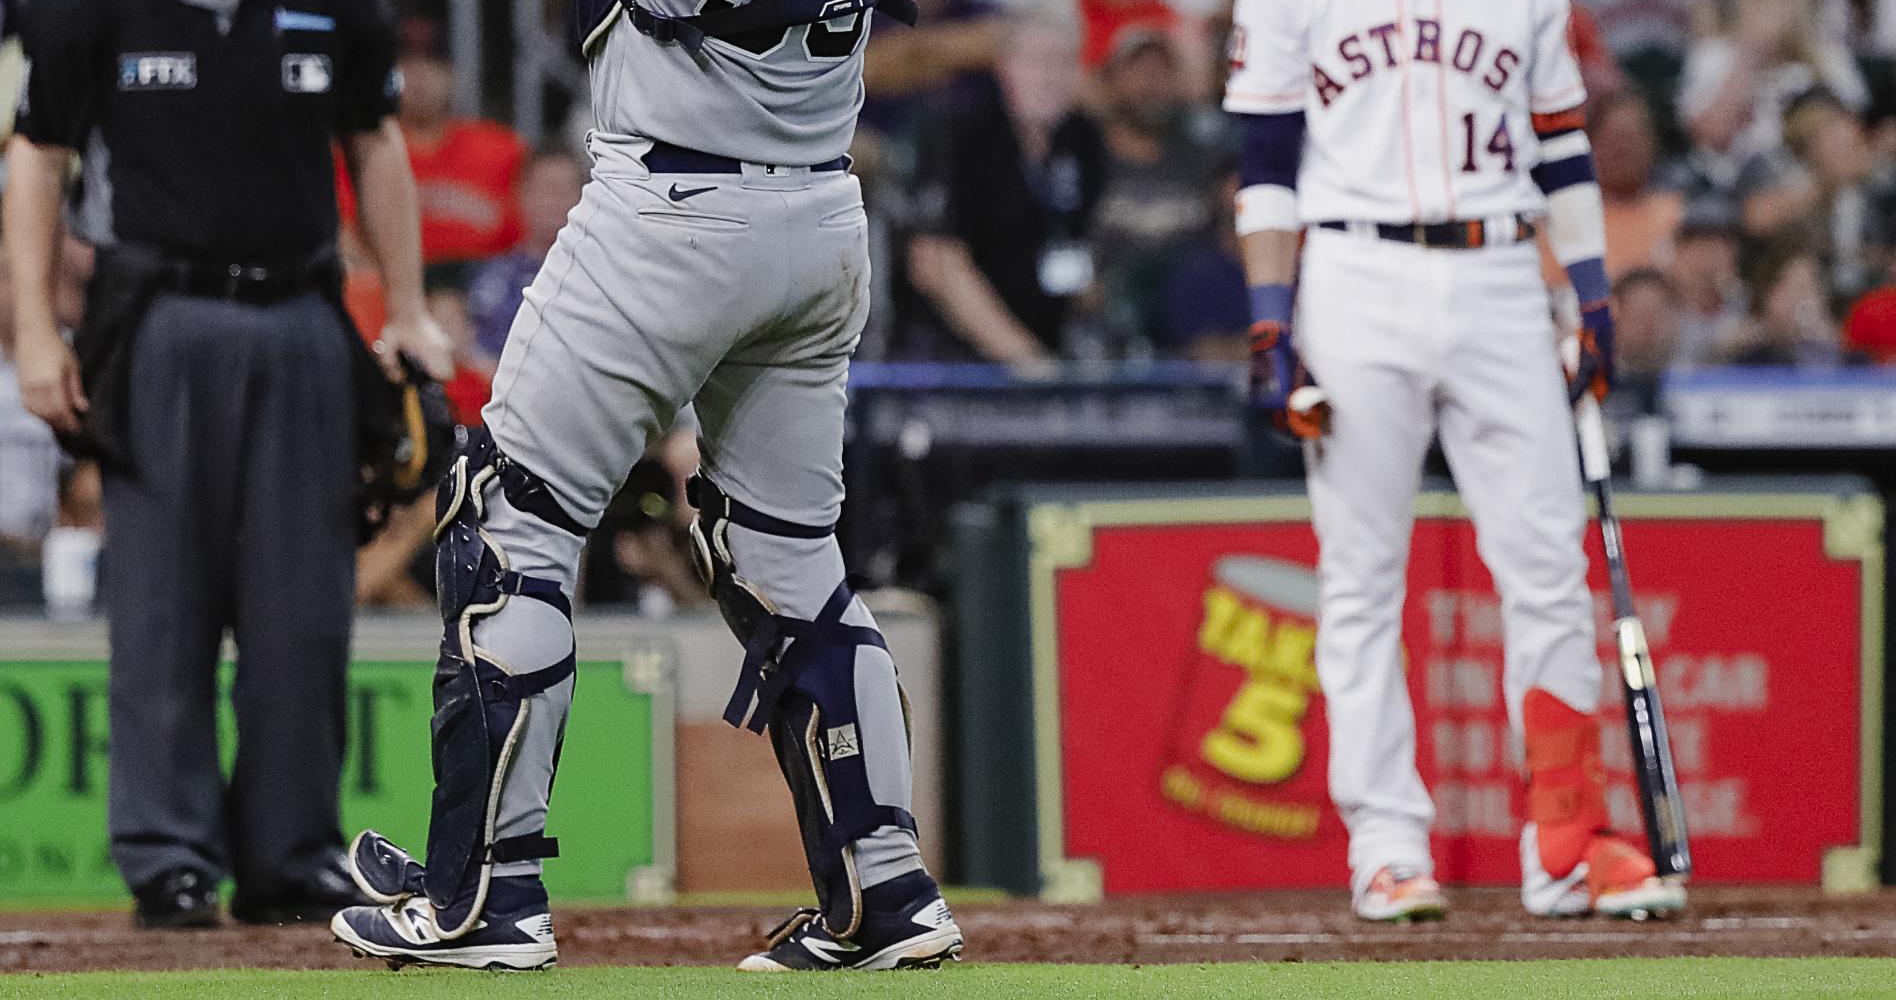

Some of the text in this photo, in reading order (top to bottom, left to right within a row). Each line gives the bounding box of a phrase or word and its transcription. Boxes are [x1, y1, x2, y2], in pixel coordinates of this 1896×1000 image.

[138, 56, 195, 85] FTX
[1313, 18, 1520, 107] ASTROS
[1461, 112, 1516, 172] 14
[1198, 584, 1324, 693] TAK
[1201, 680, 1306, 782] 5
